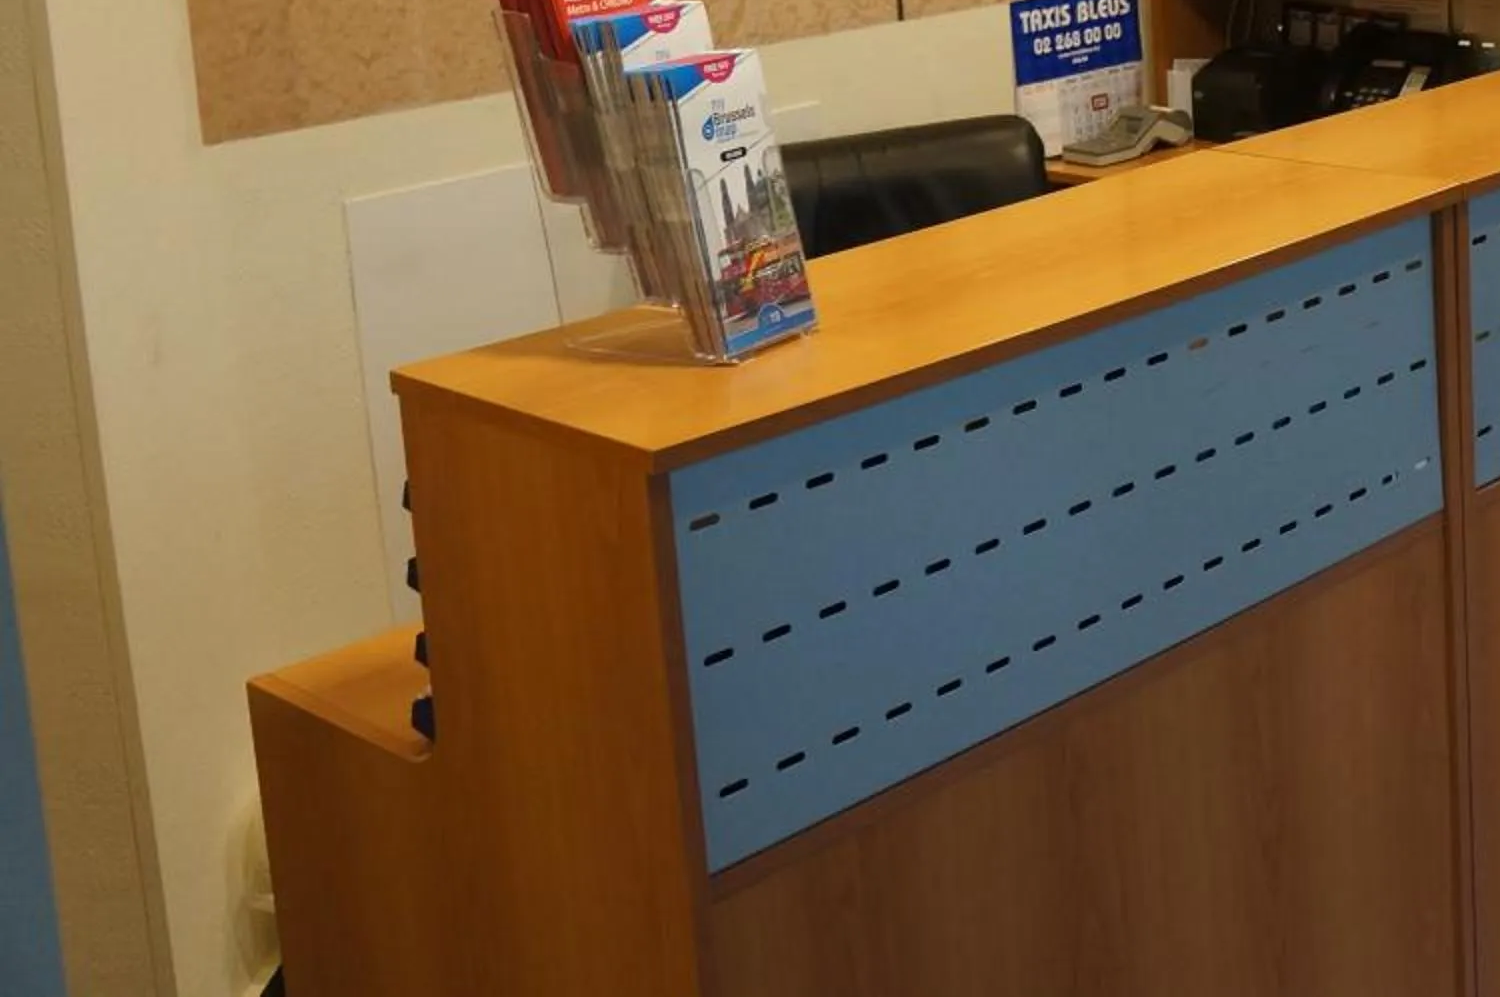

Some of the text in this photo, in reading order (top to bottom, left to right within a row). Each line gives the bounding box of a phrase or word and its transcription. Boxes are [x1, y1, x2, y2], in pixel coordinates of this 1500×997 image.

[1019, 4, 1071, 34] TAXIS
[1033, 36, 1052, 56] 02
[1055, 30, 1081, 52] 268
[1084, 26, 1101, 45] 00
[1104, 23, 1122, 40] 00
[712, 103, 756, 127] Brussels
